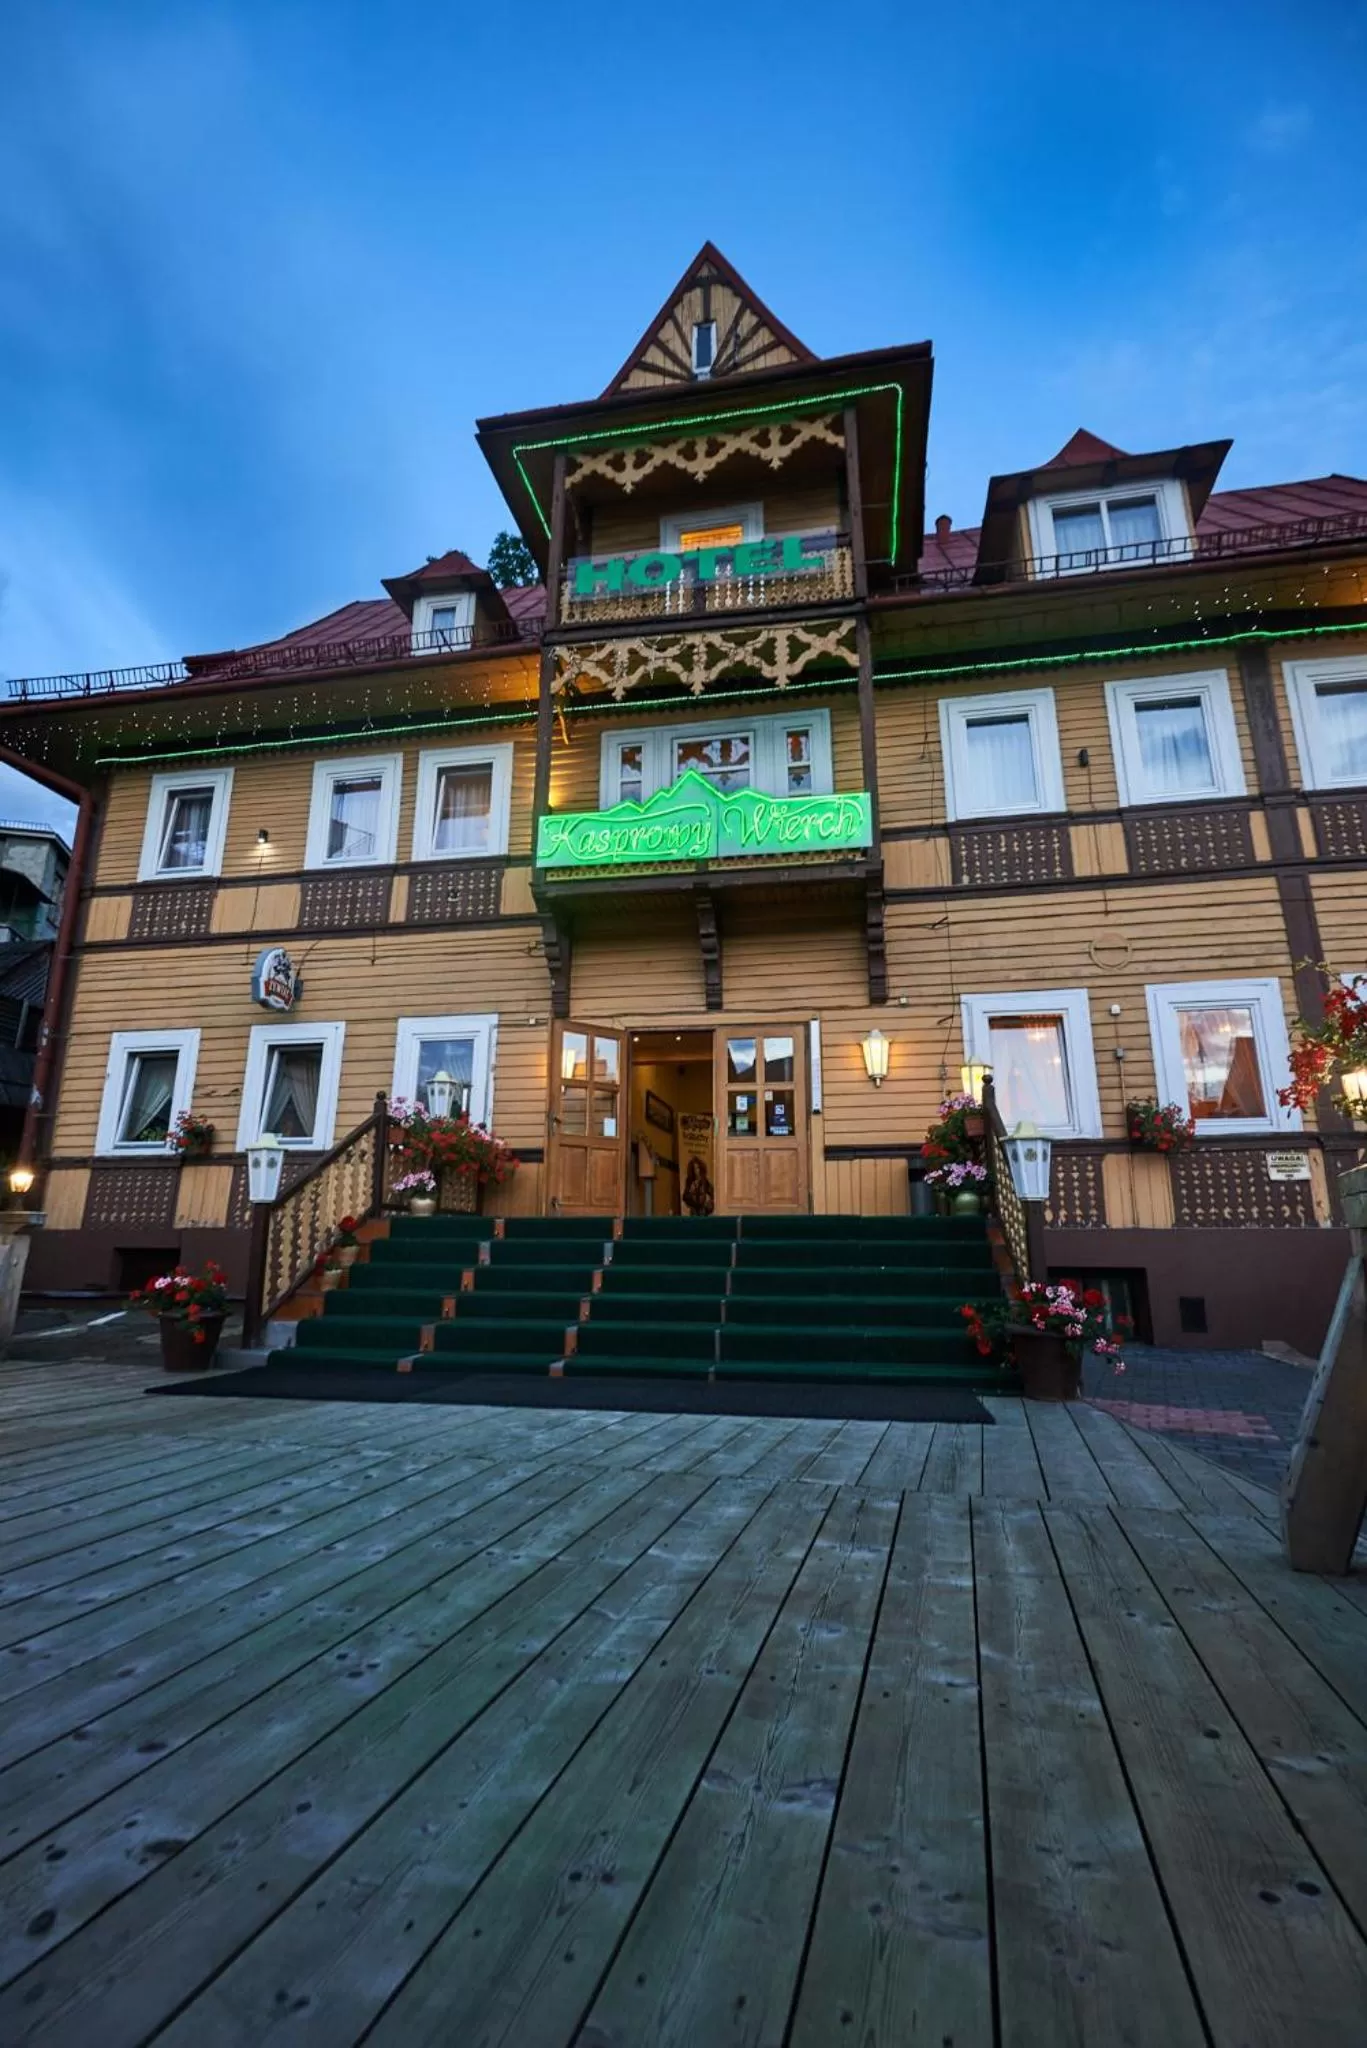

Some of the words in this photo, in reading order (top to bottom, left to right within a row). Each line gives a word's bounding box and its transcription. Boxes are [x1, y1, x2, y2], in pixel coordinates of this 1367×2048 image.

[575, 536, 826, 594] HOTEL
[539, 804, 711, 862] Kasprowy
[722, 797, 864, 846] Wierch
